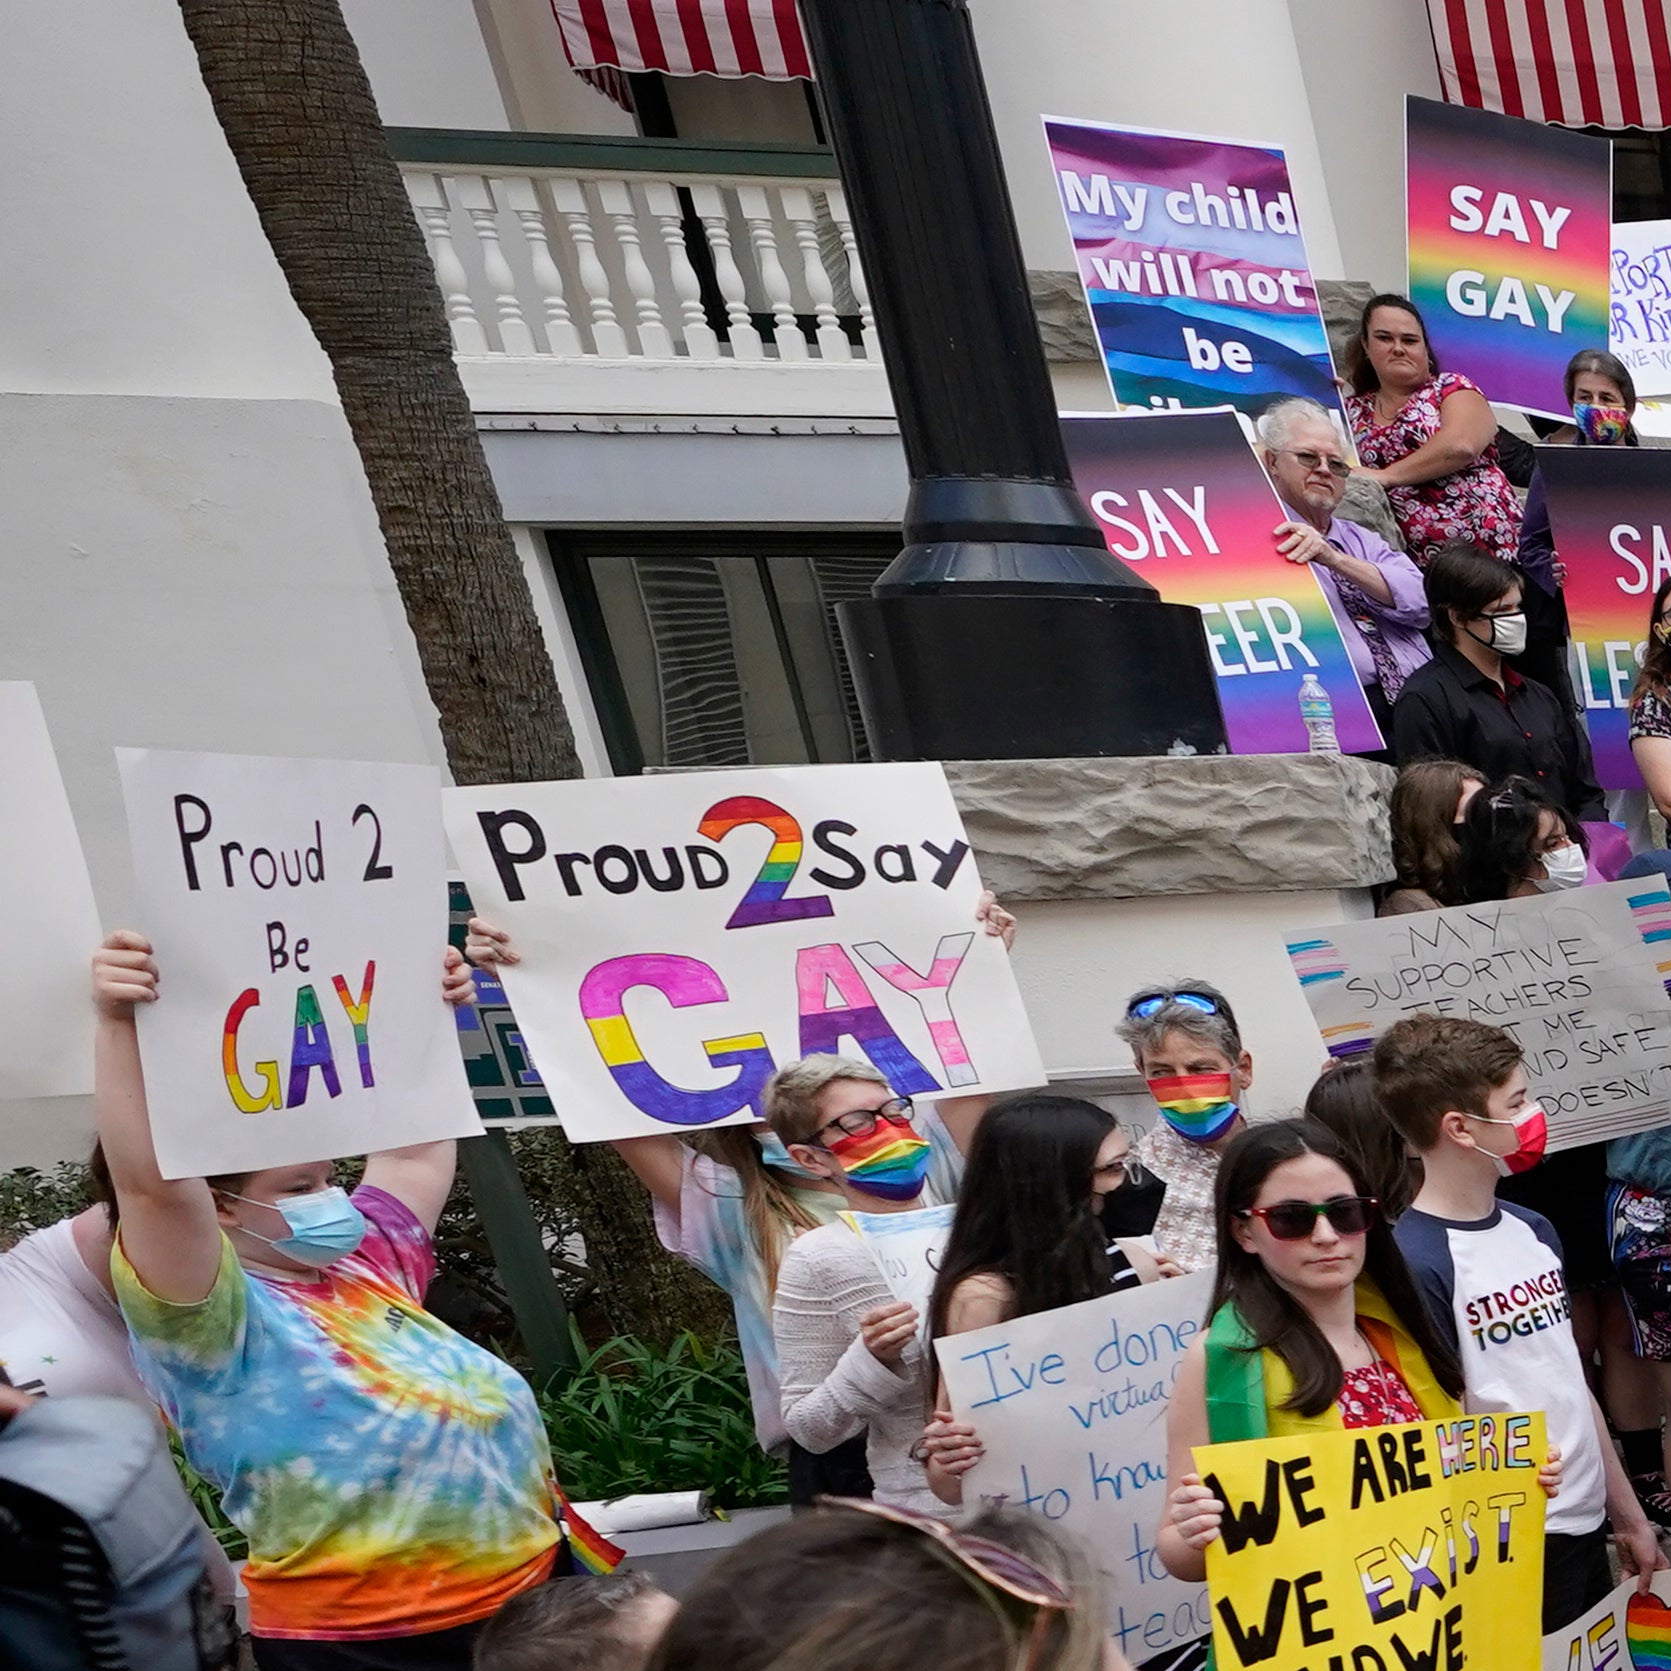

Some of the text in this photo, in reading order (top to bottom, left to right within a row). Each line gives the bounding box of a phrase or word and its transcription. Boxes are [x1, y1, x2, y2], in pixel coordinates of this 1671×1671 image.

[1060, 170, 1299, 236] My child
[1450, 184, 1572, 250] SAY
[1090, 250, 1307, 308] will not
[1446, 268, 1577, 334] GAY
[1182, 327, 1254, 373] be
[1090, 485, 1223, 561] SAY
[174, 793, 394, 892] Proud 2
[696, 794, 970, 931] 2 Say
[266, 921, 311, 973] Be
[1408, 912, 1502, 958] MY
[1347, 938, 1600, 1010] SUPPORTIVE
[1401, 974, 1594, 1020] TEACHERS
[222, 959, 376, 1114] GAY
[579, 931, 981, 1126] GAY
[1543, 1009, 1598, 1040] ME
[1579, 1026, 1669, 1067] SAFE
[960, 1317, 1199, 1410] I've done
[1019, 1464, 1072, 1521] to
[1204, 1414, 1537, 1557] WE ARE HERE.
[1216, 1570, 1335, 1668] WE
